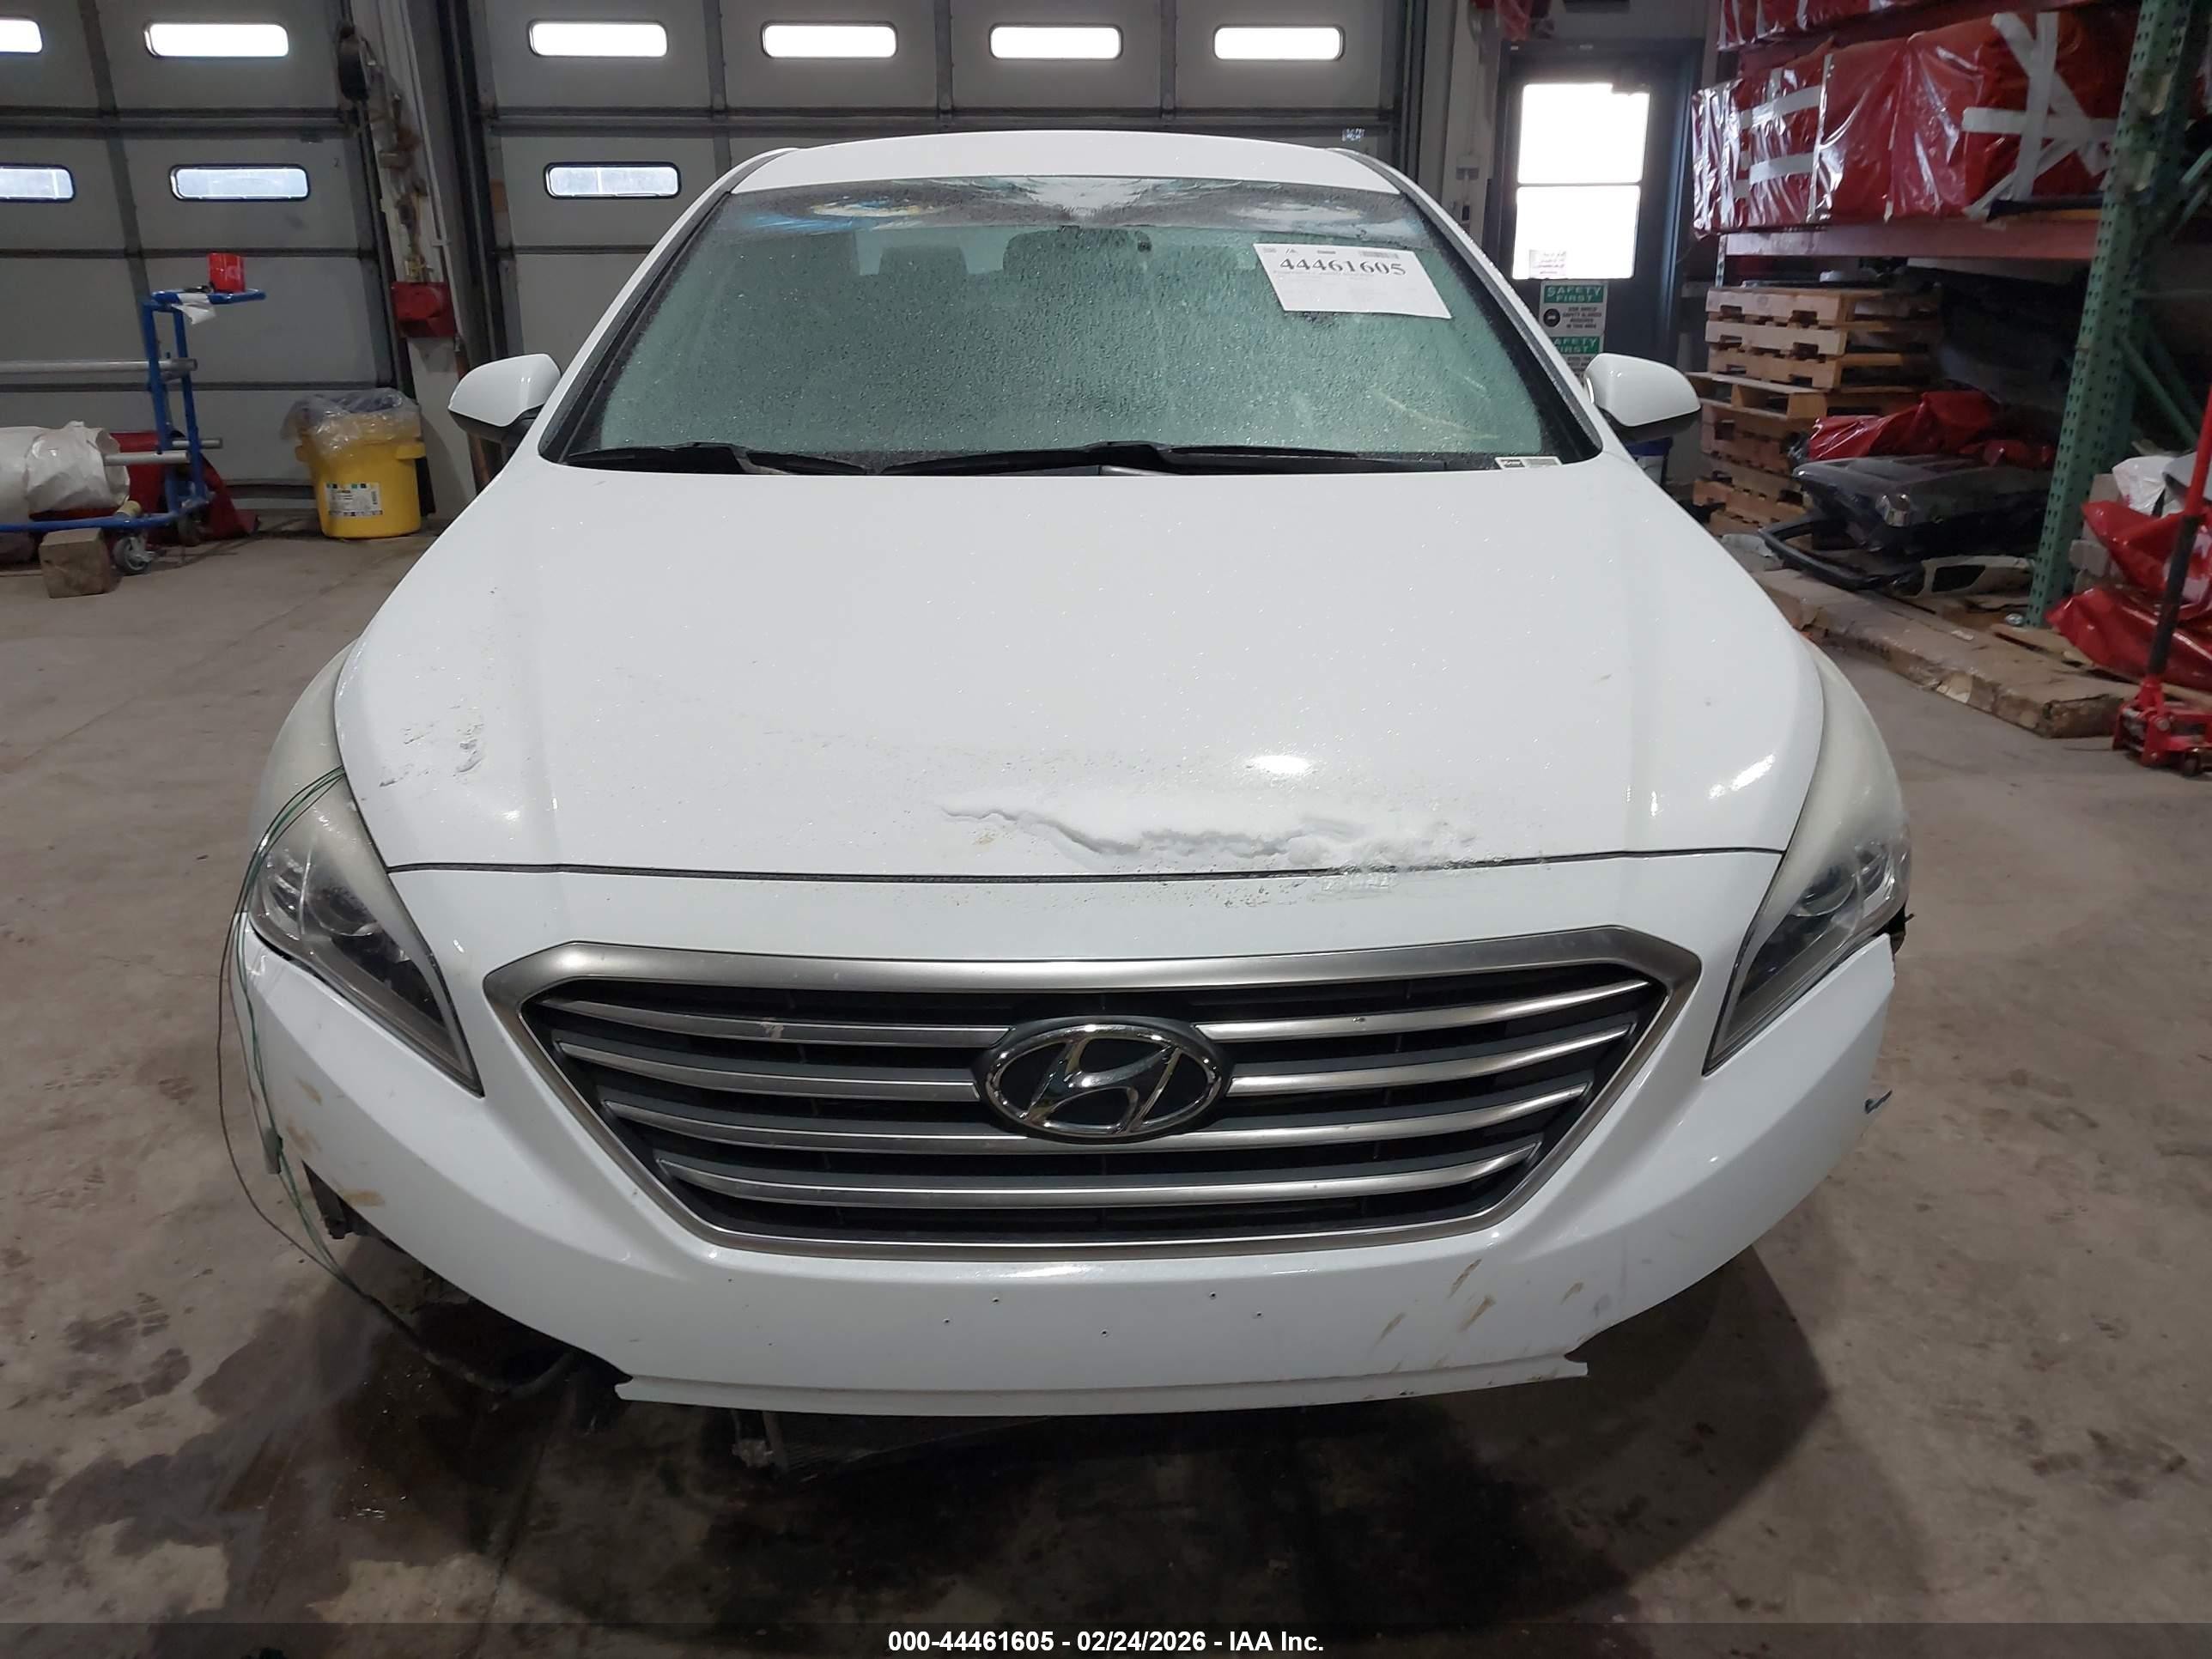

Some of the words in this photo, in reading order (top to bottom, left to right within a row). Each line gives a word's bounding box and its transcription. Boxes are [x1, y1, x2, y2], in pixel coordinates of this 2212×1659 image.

[1279, 258, 1407, 276] 44461605
[1547, 286, 1601, 297] SAFETY
[1553, 337, 1598, 348] AFETY
